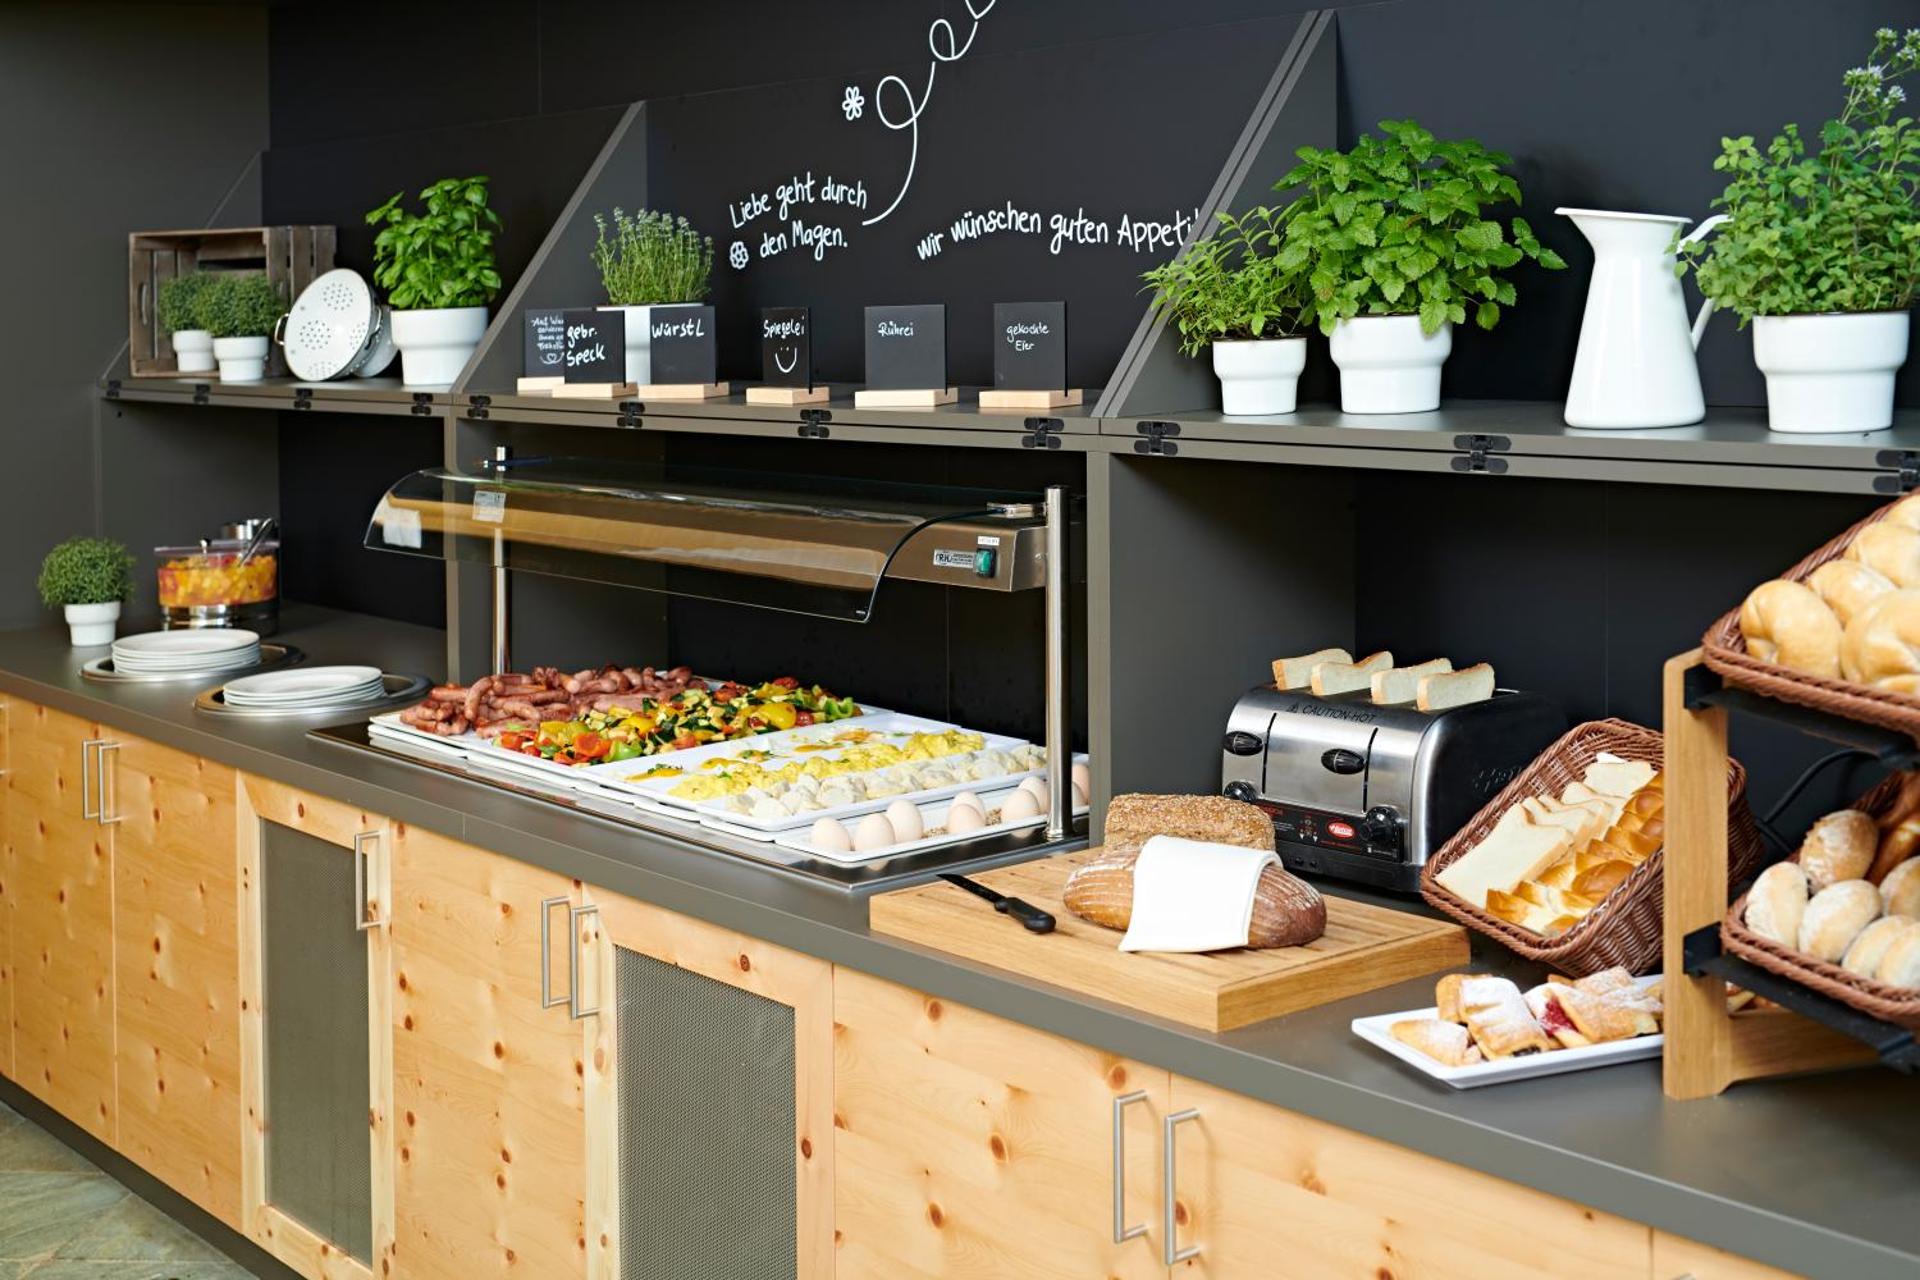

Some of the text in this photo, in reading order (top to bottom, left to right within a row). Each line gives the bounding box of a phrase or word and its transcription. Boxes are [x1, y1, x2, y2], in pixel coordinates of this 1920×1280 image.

[729, 171, 867, 229] Liebe geht durch
[759, 219, 848, 261] den Magen.
[950, 200, 1042, 243] wünschen
[1049, 207, 1110, 255] guten
[1116, 207, 1199, 253] Appeti
[877, 320, 914, 337] Rührei
